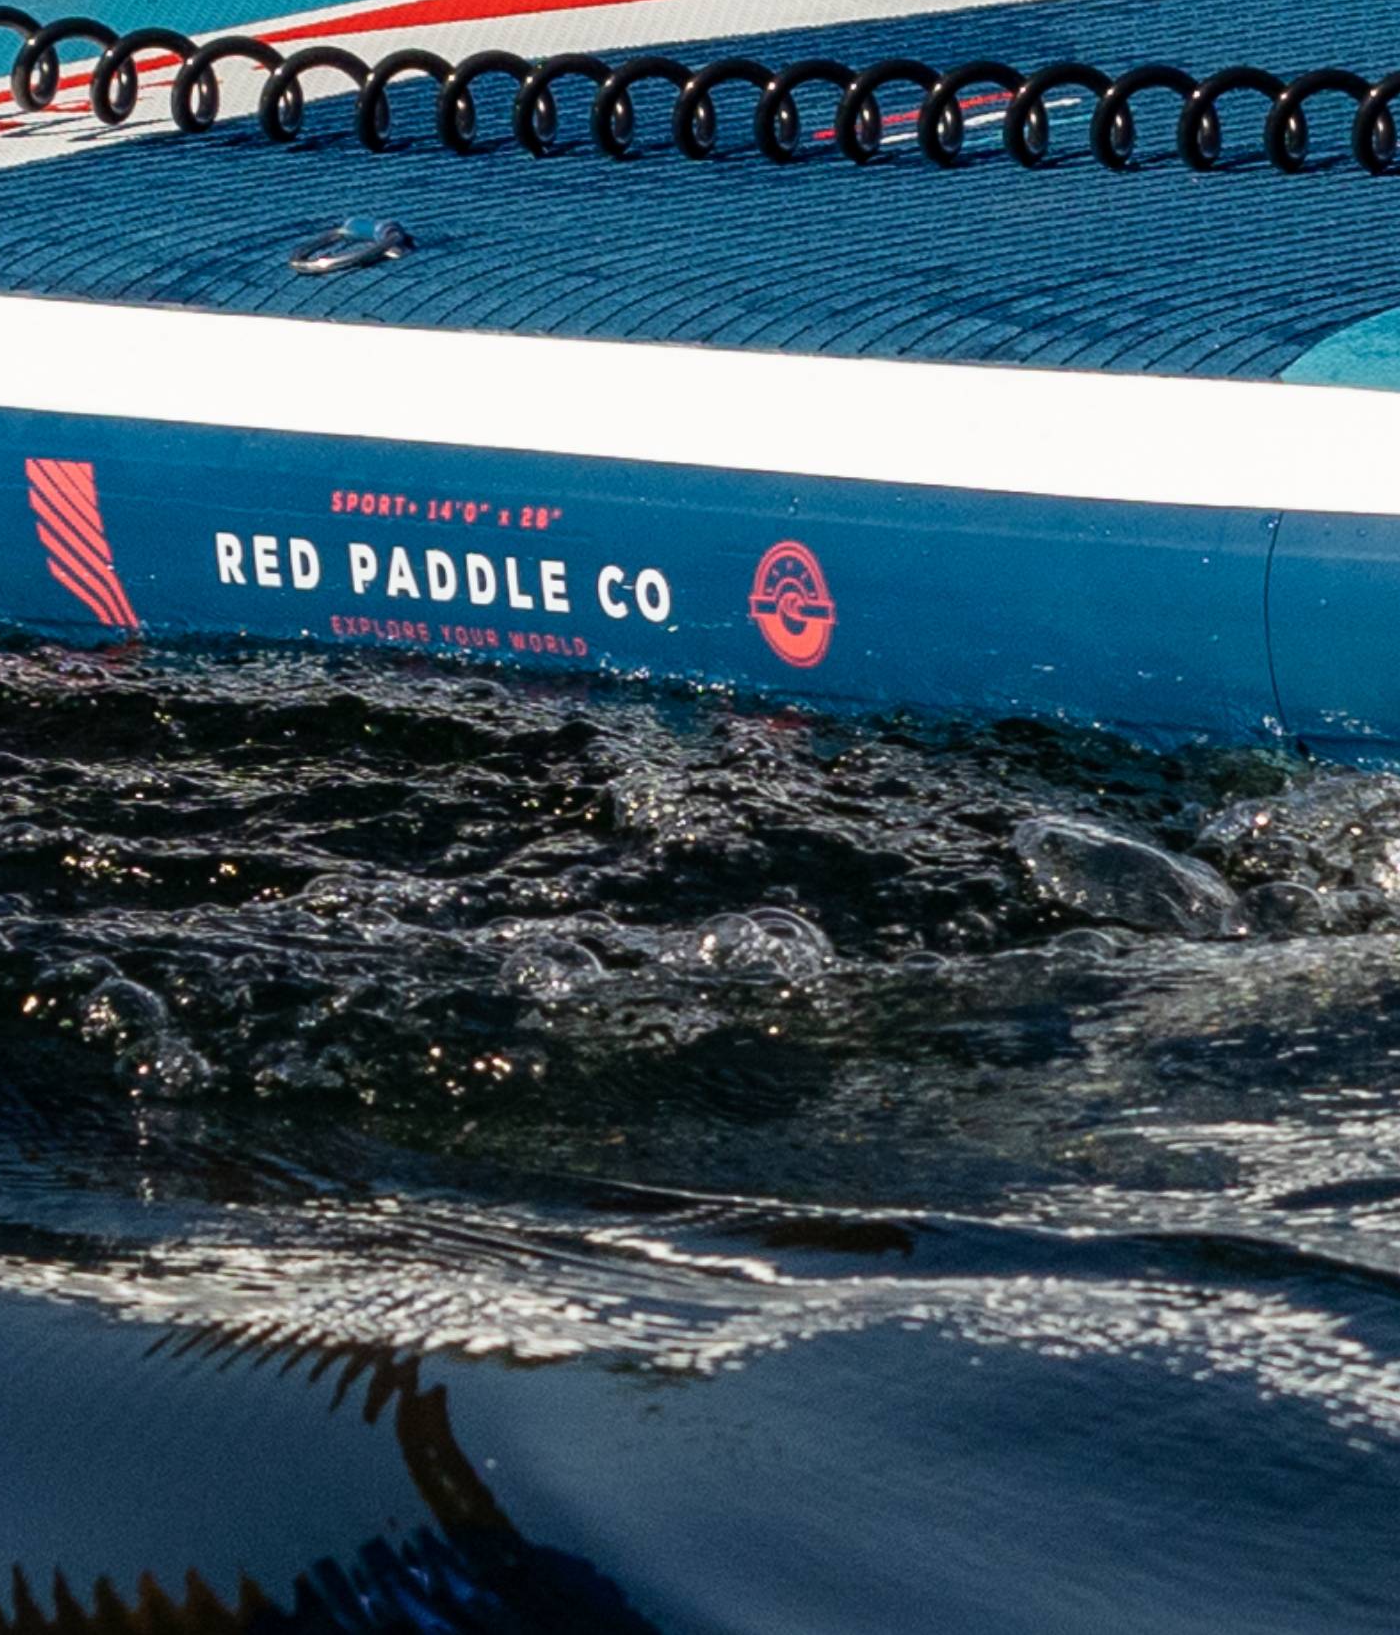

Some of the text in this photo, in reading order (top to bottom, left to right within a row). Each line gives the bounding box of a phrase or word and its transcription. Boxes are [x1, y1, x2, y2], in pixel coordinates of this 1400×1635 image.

[331, 490, 418, 515] SPORT+
[215, 531, 671, 622] RED PADDLE CO
[330, 615, 588, 657] EXPLORE YOUR WORLD
